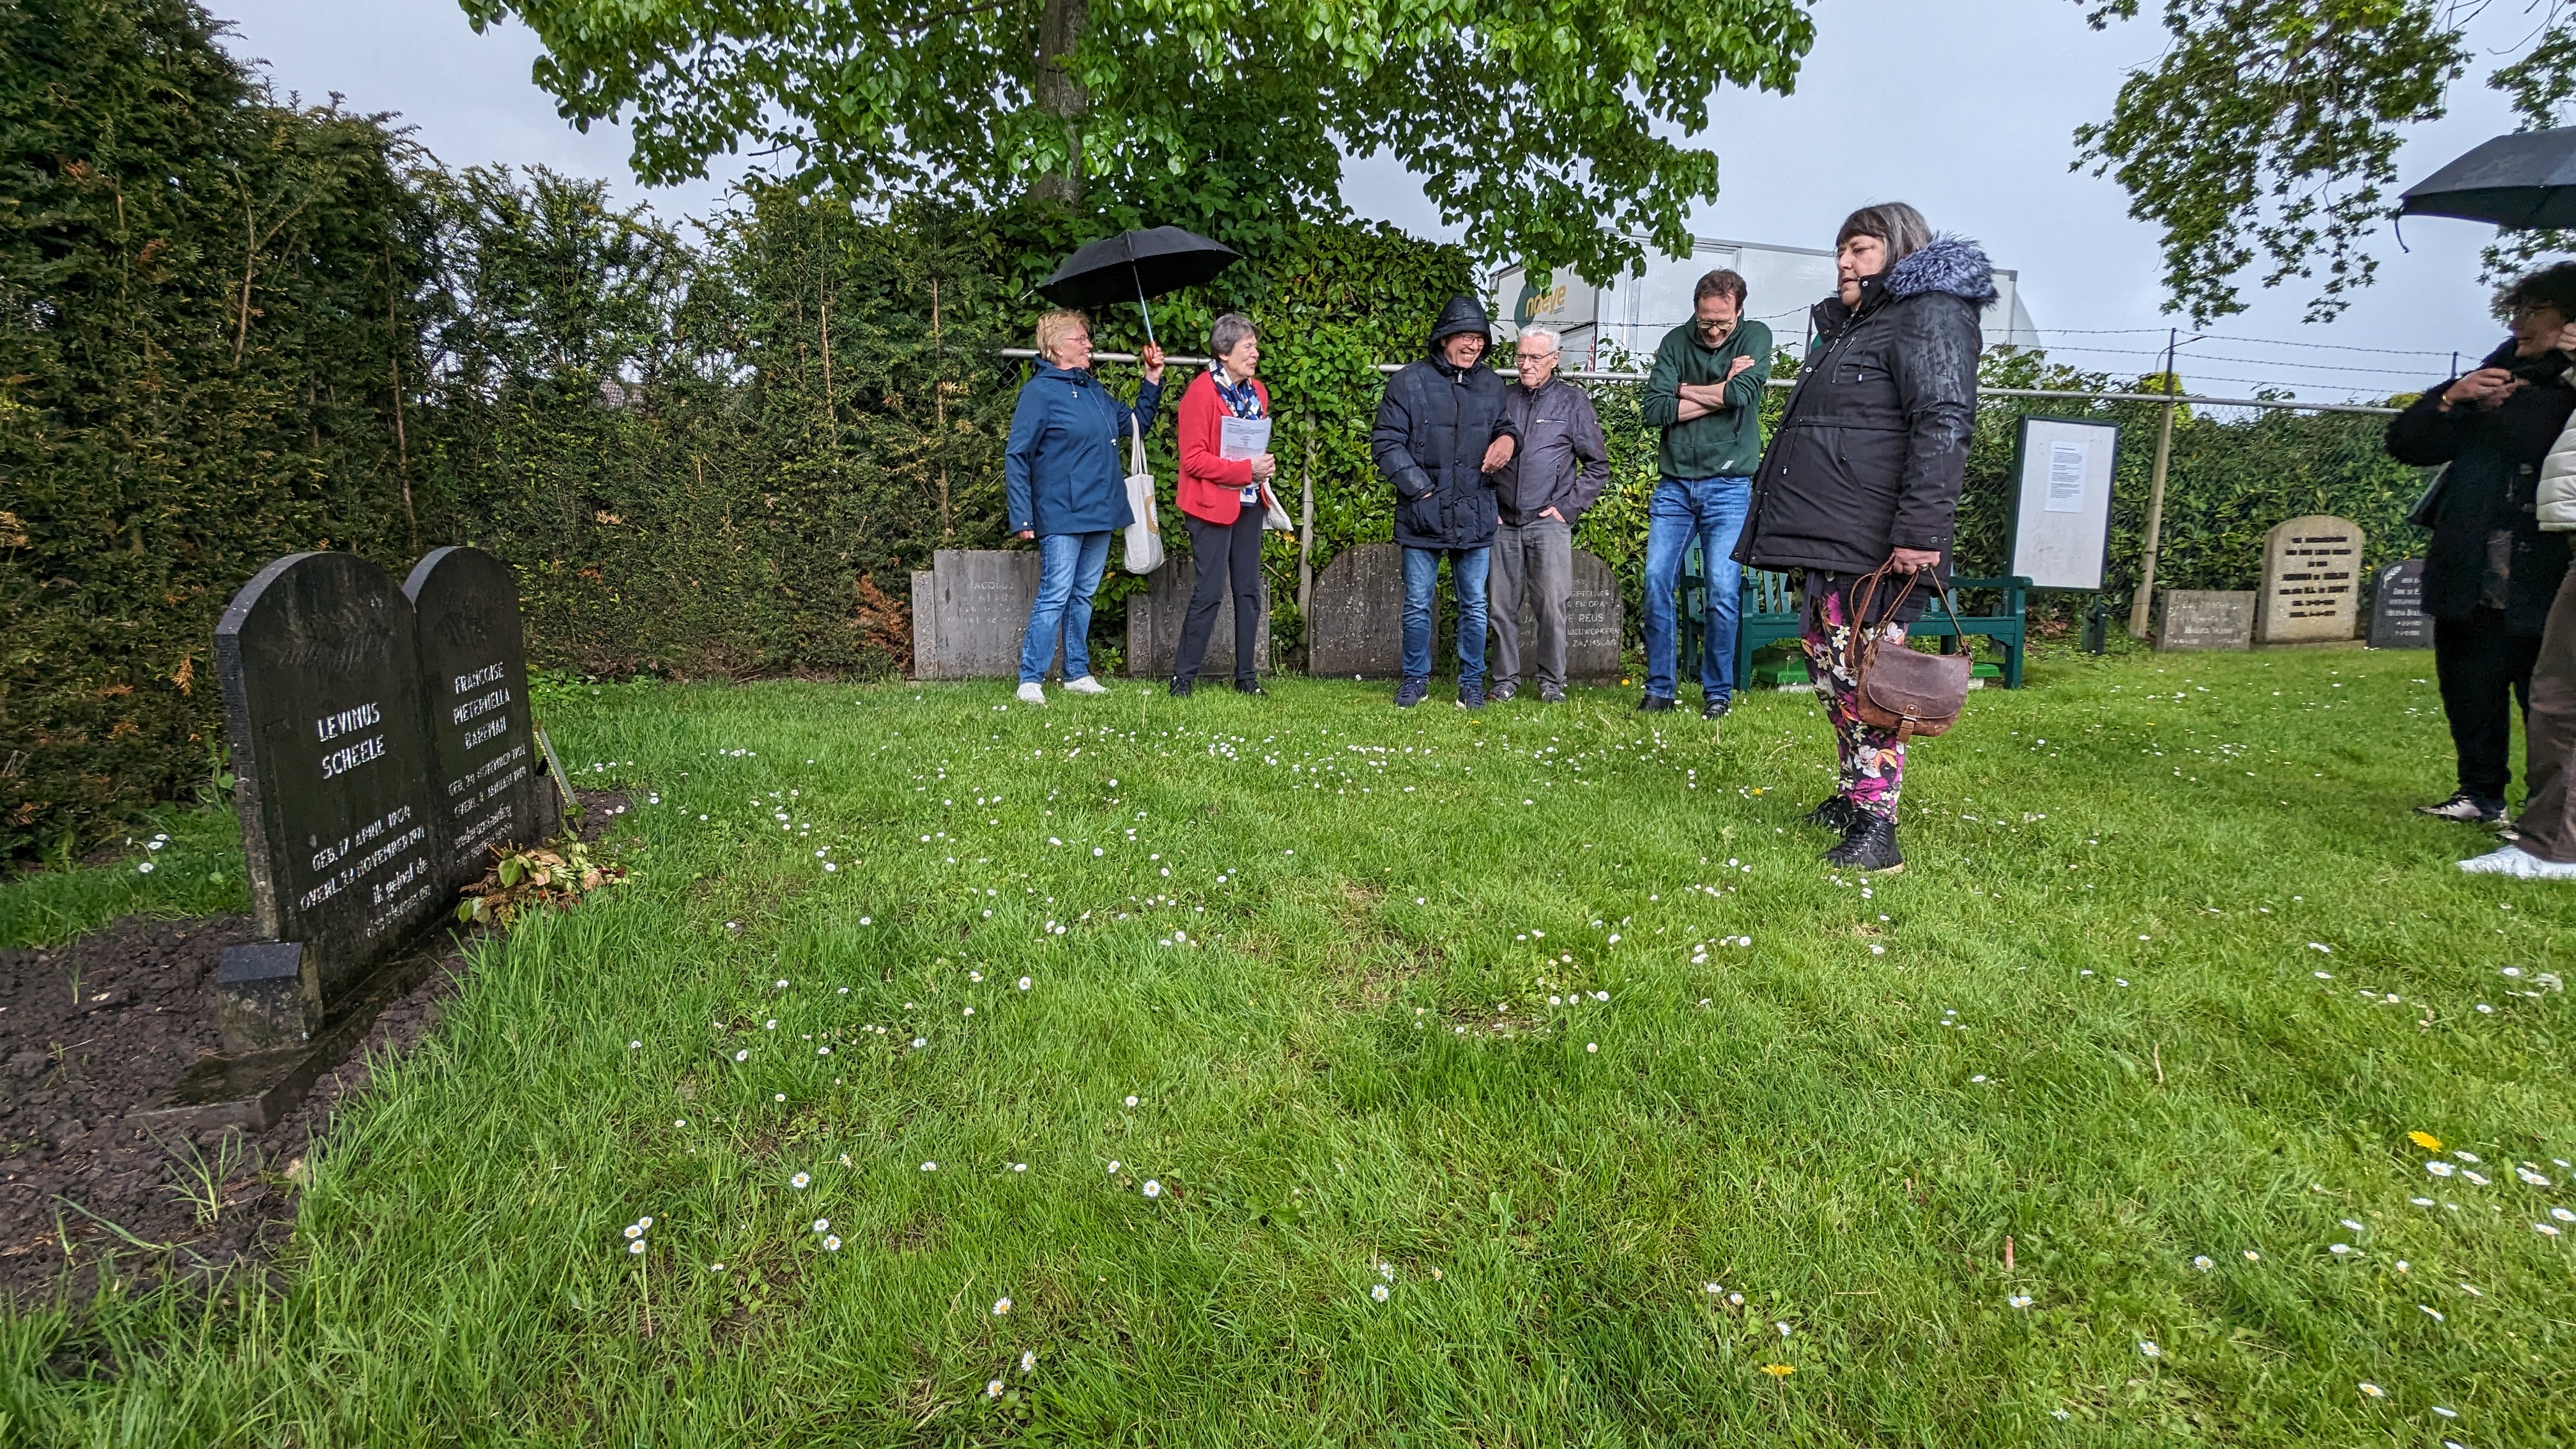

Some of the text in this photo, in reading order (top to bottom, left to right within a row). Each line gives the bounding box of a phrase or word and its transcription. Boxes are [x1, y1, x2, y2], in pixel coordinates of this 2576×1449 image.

[1525, 285, 1567, 318] naeye
[1579, 613, 1604, 623] REUS
[317, 701, 381, 742] LEVINUS
[453, 687, 510, 726] PIETERNELLA
[464, 715, 507, 750] BAREMAN
[321, 733, 386, 779] SCHEELE
[477, 751, 510, 778] NOVEMBER
[487, 773, 512, 799] JANUARI
[312, 804, 411, 871] GEB. 17 APRIL 1904
[300, 877, 342, 911] OVERL.
[356, 834, 409, 878] NOVEMBER
[409, 825, 425, 845] 1971
[417, 856, 428, 875] de
